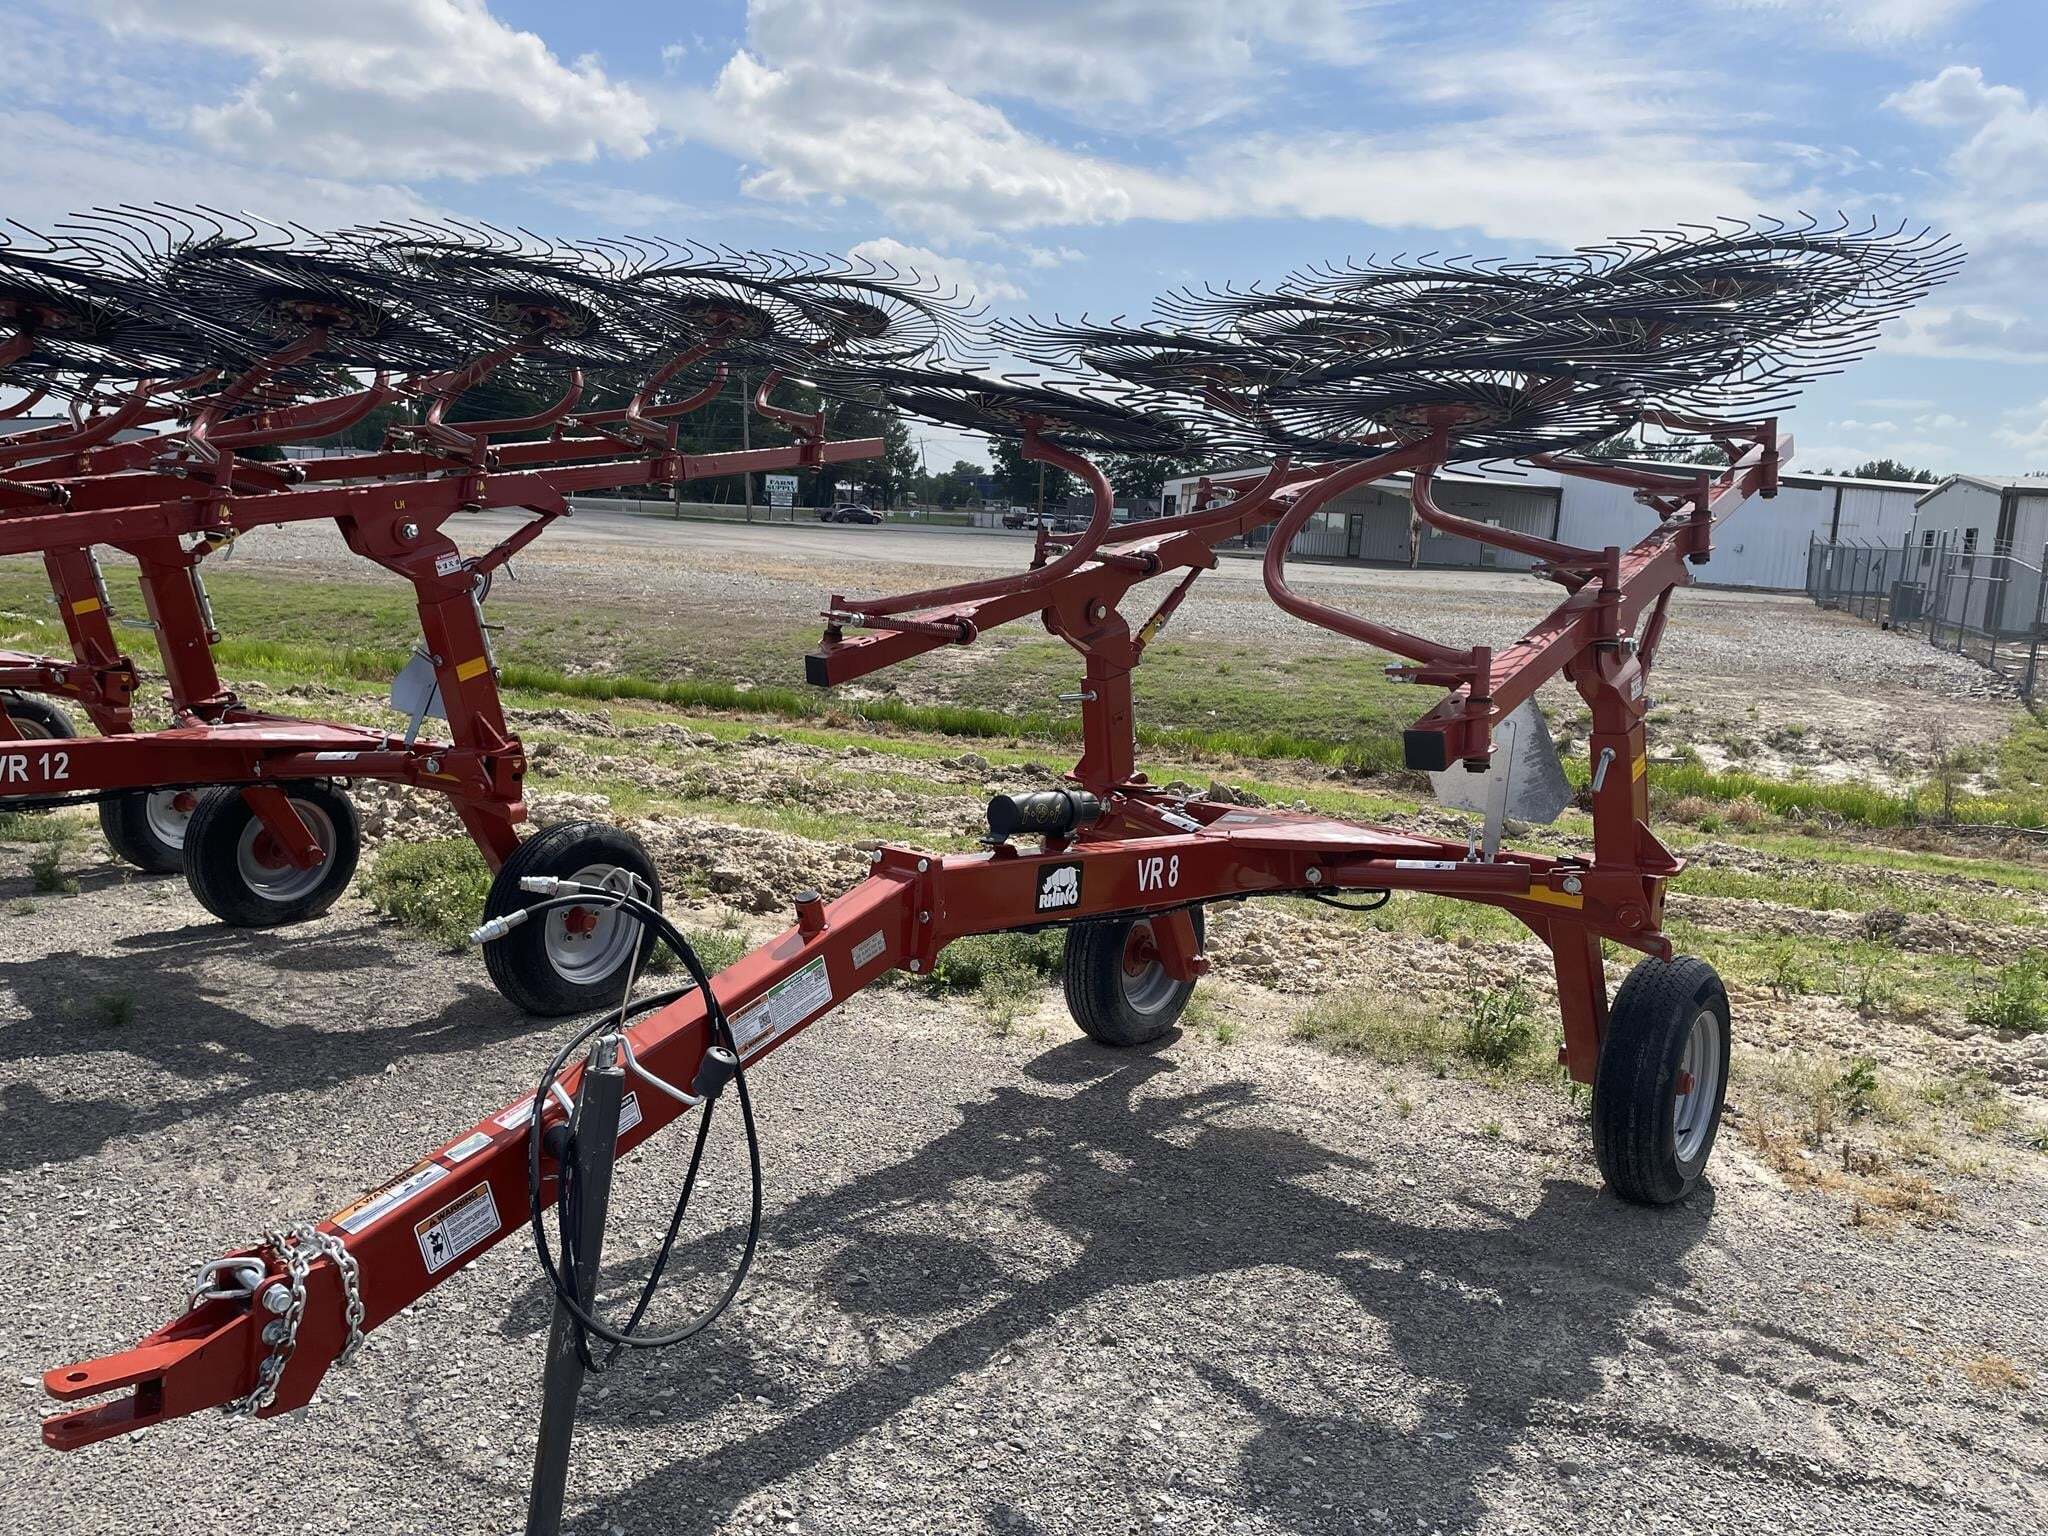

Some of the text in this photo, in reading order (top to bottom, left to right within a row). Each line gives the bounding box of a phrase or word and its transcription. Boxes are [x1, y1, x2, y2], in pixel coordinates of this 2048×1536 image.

[38, 752, 69, 780] 12
[1137, 855, 1179, 892] VR 8
[363, 1171, 415, 1205] WARNING
[436, 1191, 479, 1222] WARNING
